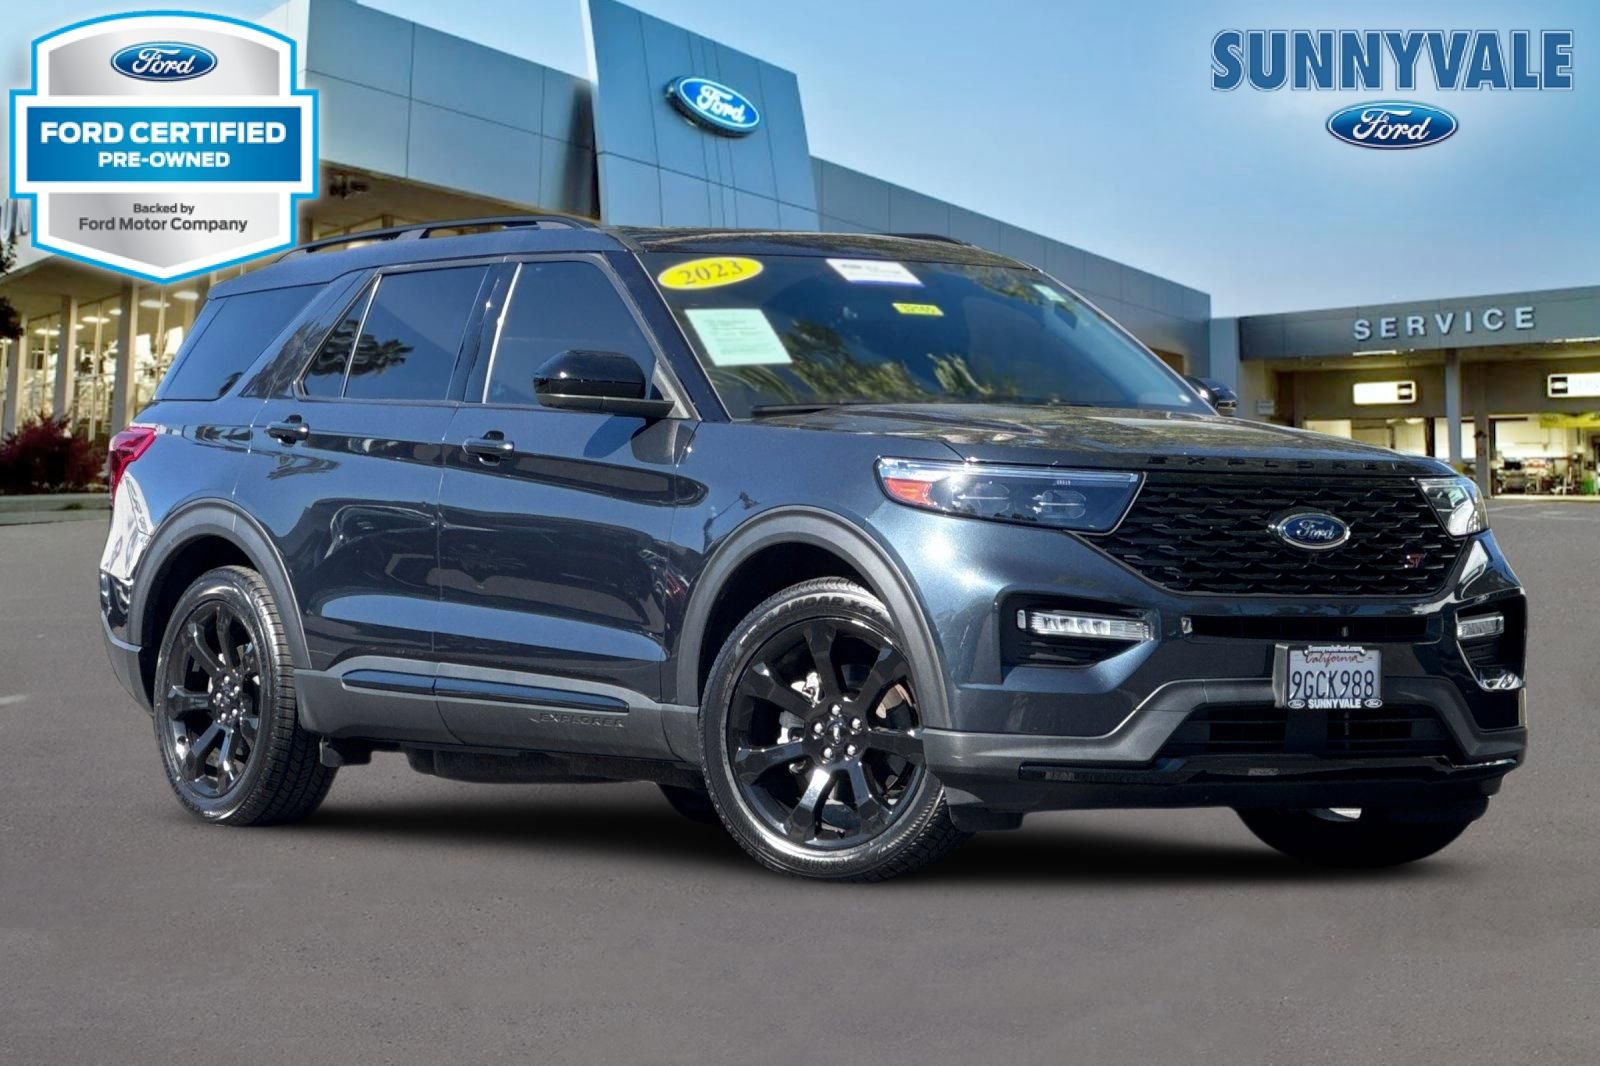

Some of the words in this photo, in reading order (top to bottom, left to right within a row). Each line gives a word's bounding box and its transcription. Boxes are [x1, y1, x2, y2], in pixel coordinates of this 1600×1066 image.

[696, 84, 745, 123] Ford
[678, 260, 744, 286] 2023
[1353, 306, 1536, 341] SERVICE
[1296, 519, 1335, 540] Ford
[1306, 652, 1363, 667] California
[1291, 670, 1374, 699] 9GCK988
[1308, 699, 1361, 708] SUNNYVALE
